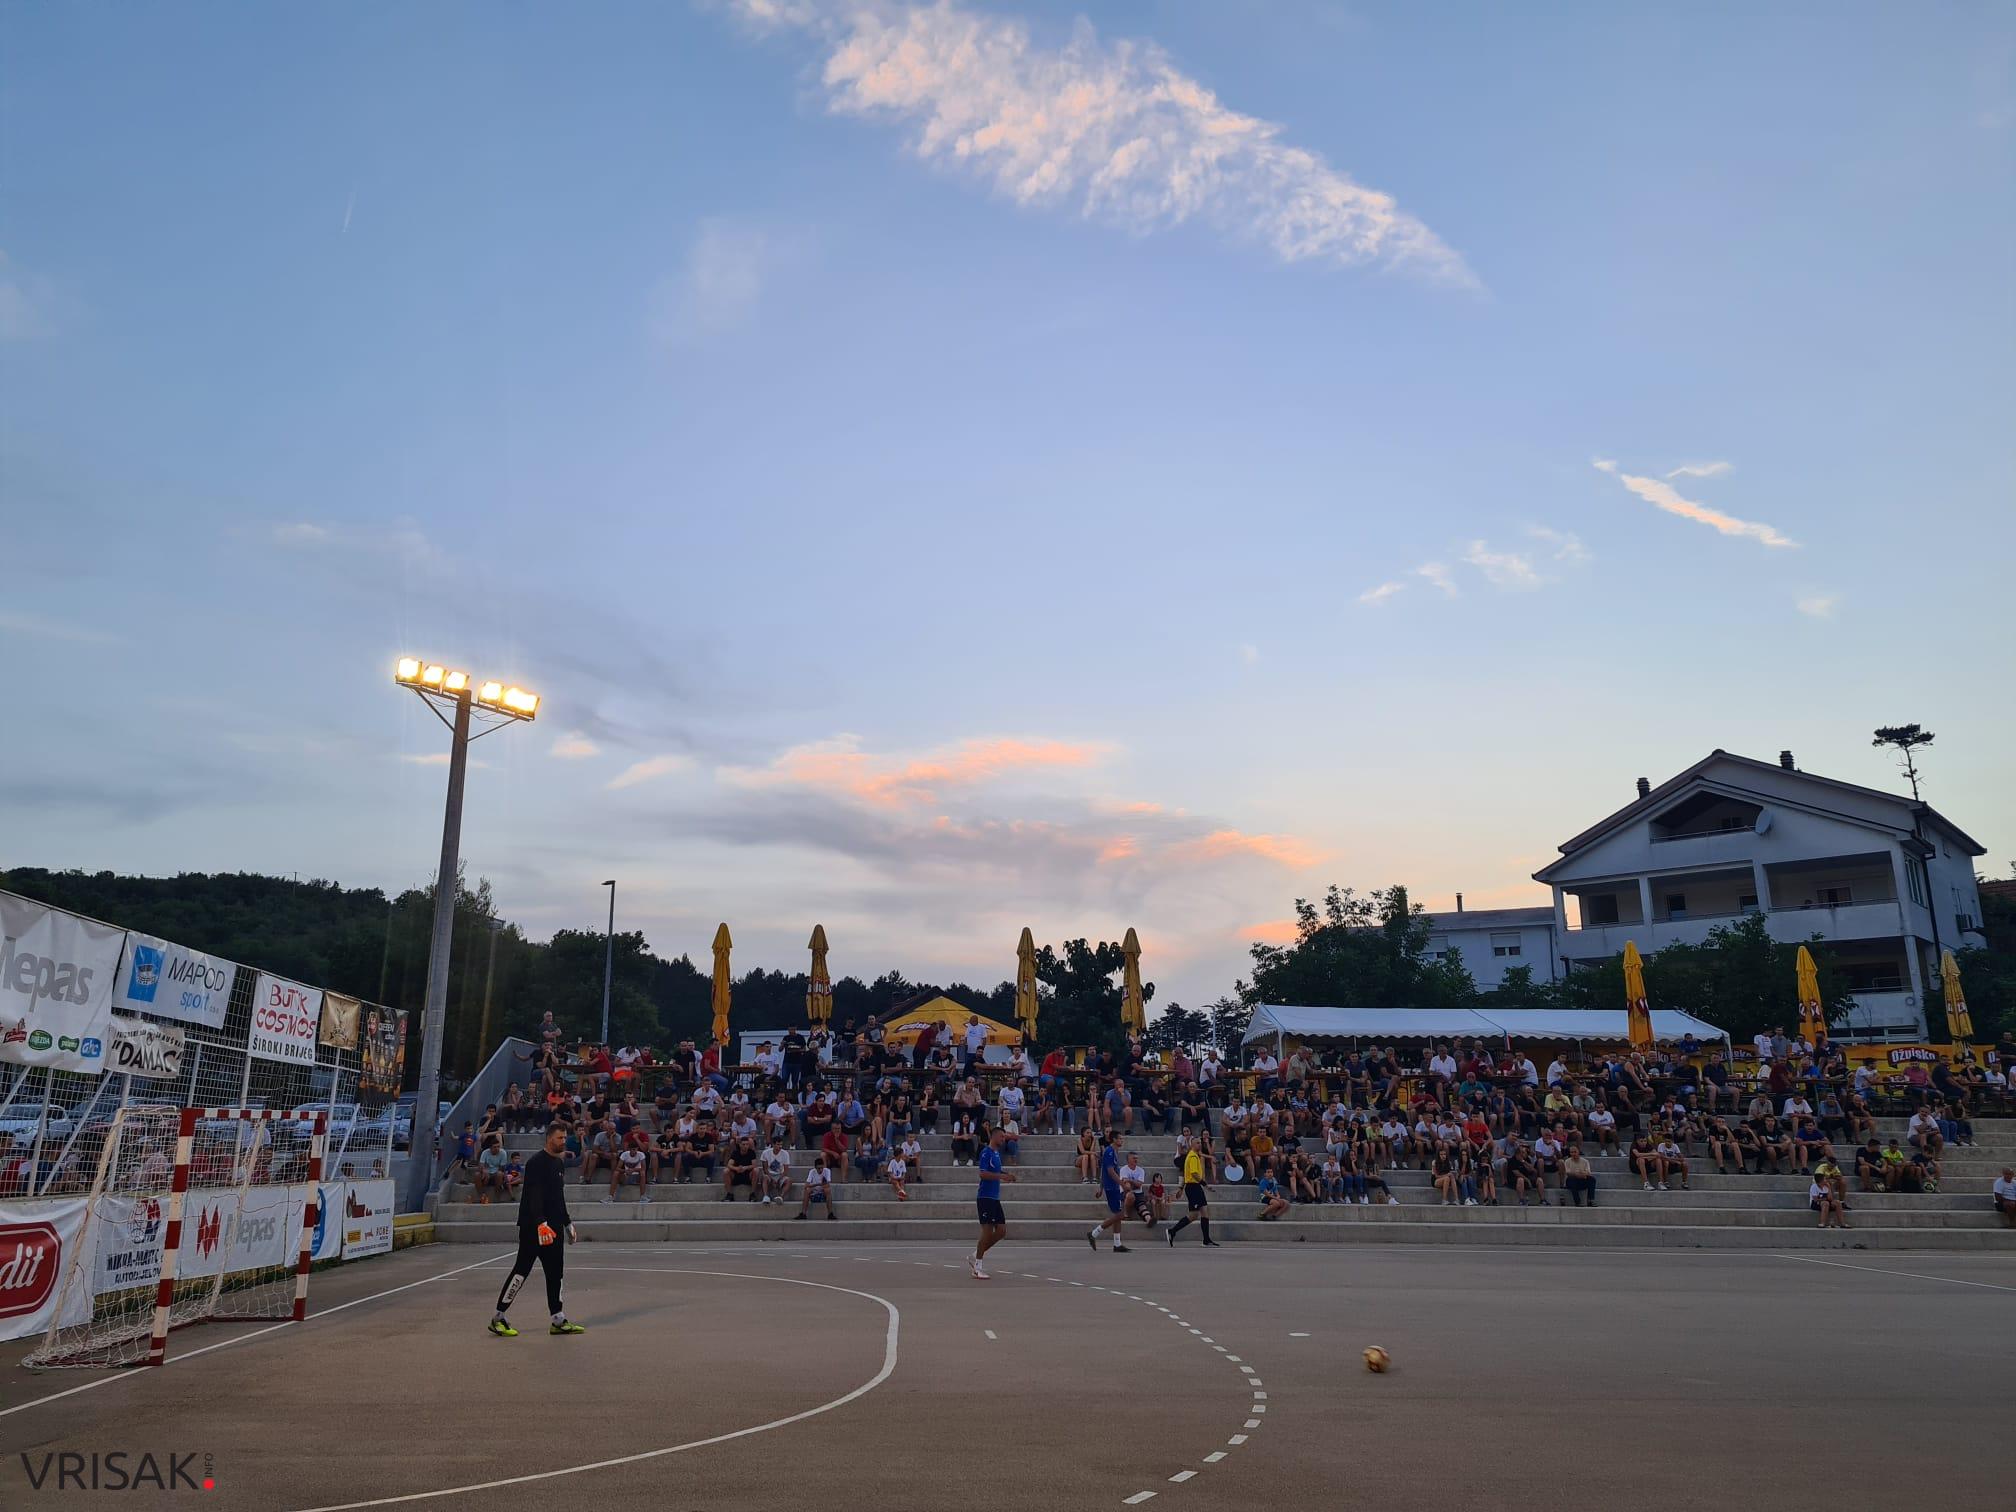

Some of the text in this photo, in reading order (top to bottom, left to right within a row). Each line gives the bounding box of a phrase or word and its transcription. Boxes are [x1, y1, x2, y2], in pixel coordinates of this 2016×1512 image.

[167, 957, 226, 992] MAPOD
[256, 1007, 317, 1040] COSMOS
[252, 1034, 313, 1060] ŠIROKI BRIJEG
